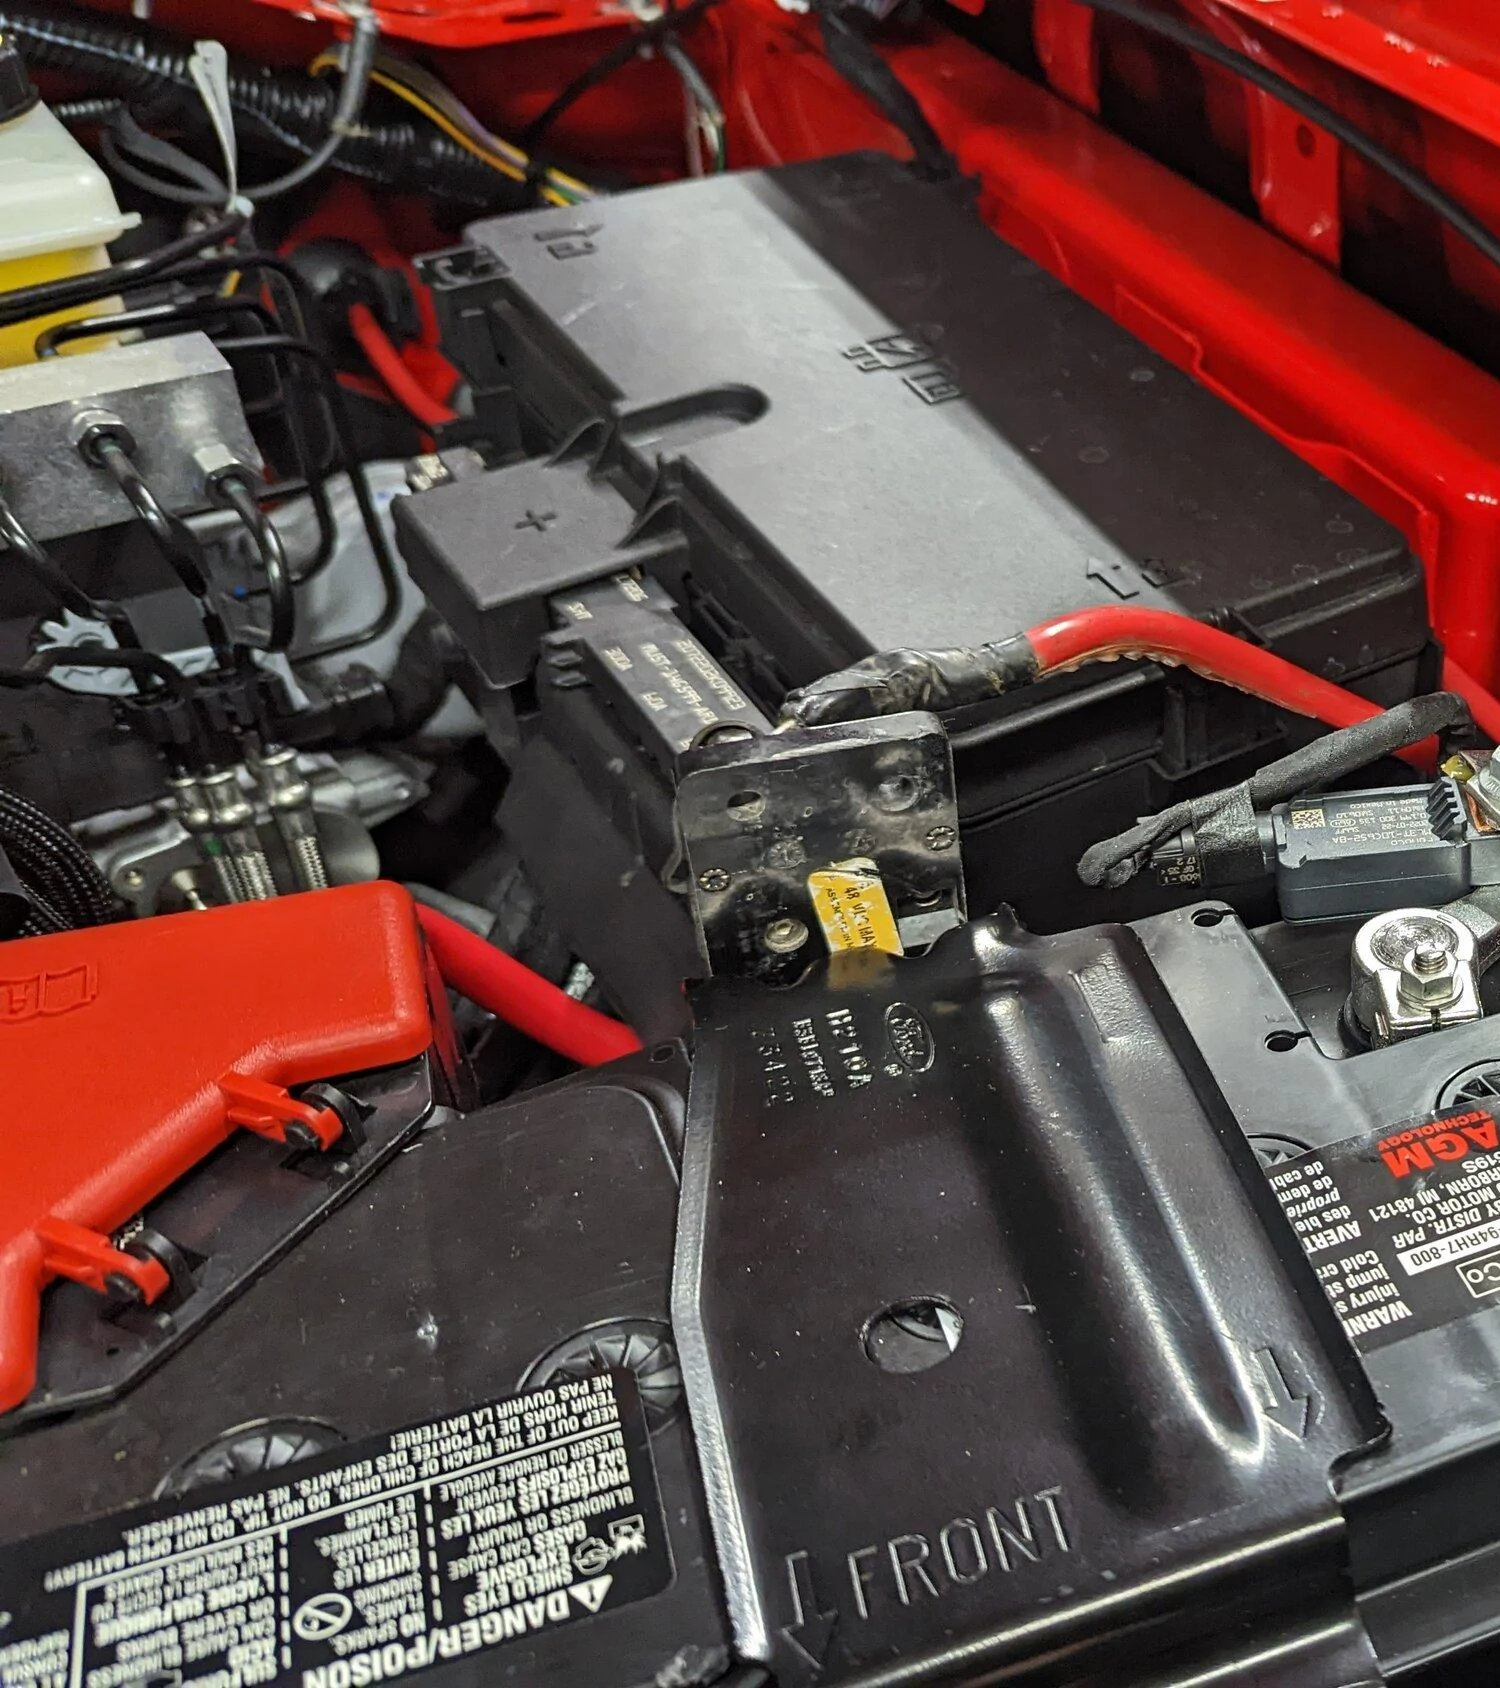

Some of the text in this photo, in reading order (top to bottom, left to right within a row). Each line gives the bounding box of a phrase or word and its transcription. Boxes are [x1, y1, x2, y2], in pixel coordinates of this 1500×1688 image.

[1376, 1108, 1492, 1151] TECHNOLOGY
[1379, 1120, 1500, 1180] AGM
[1302, 1160, 1327, 1178] de
[1310, 1175, 1334, 1191] de
[1282, 1187, 1342, 1217] proprie
[1366, 1195, 1418, 1221] 48121
[1415, 1187, 1440, 1204] MI
[1435, 1186, 1496, 1215] MOTOR
[1320, 1204, 1352, 1224] des
[1404, 1206, 1437, 1226] CO.
[1426, 1208, 1483, 1235] DISTR.
[1299, 1219, 1365, 1253] AVERT
[1389, 1226, 1427, 1248] PAR
[1337, 1248, 1380, 1273] Cold
[1341, 1262, 1389, 1289] jump
[1346, 1280, 1399, 1308] injury
[556, 1378, 590, 1401] PAS
[590, 1370, 612, 1391] NE
[495, 1388, 555, 1419] OUVRIR
[522, 1401, 567, 1429] HORS
[570, 1387, 615, 1415] TENIR
[470, 1407, 493, 1427] LA
[498, 1415, 520, 1437] DE
[548, 1414, 579, 1438] OUT
[581, 1403, 618, 1428] KEEP
[474, 1422, 496, 1444] LA
[493, 1431, 524, 1455] THE
[525, 1424, 546, 1445] OF
[375, 1448, 408, 1474] DES
[417, 1456, 439, 1478] OF
[438, 1429, 623, 1502] BLESSER OU RENDRE AVEUGLE
[441, 1440, 492, 1471] REACH
[453, 1445, 627, 1515] GAZ EXPLOSIFS PEUVENT
[230, 1491, 264, 1519] PAS
[266, 1484, 289, 1509] NE
[271, 1497, 304, 1524] NOT
[306, 1489, 330, 1513] DO
[517, 1487, 548, 1515] LES
[344, 1492, 416, 1531] DE FUMER
[465, 1484, 634, 1554] BLINDNESS OR INJURY
[472, 1498, 516, 1530] YEUX
[174, 1525, 207, 1553] NOT
[210, 1517, 234, 1542] DO
[439, 1511, 471, 1541] LES
[127, 1535, 171, 1567] OPEN
[446, 1518, 587, 1581] GASES CAN CAUSE
[847, 1483, 1074, 1622] FRONT
[475, 1544, 569, 1591] EXPLOSIVE
[352, 1570, 422, 1610] SMOKING
[462, 1562, 573, 1618] SHIELD EYES
[398, 1609, 426, 1638] NO
[302, 1588, 571, 1688] DANGER/POISON
